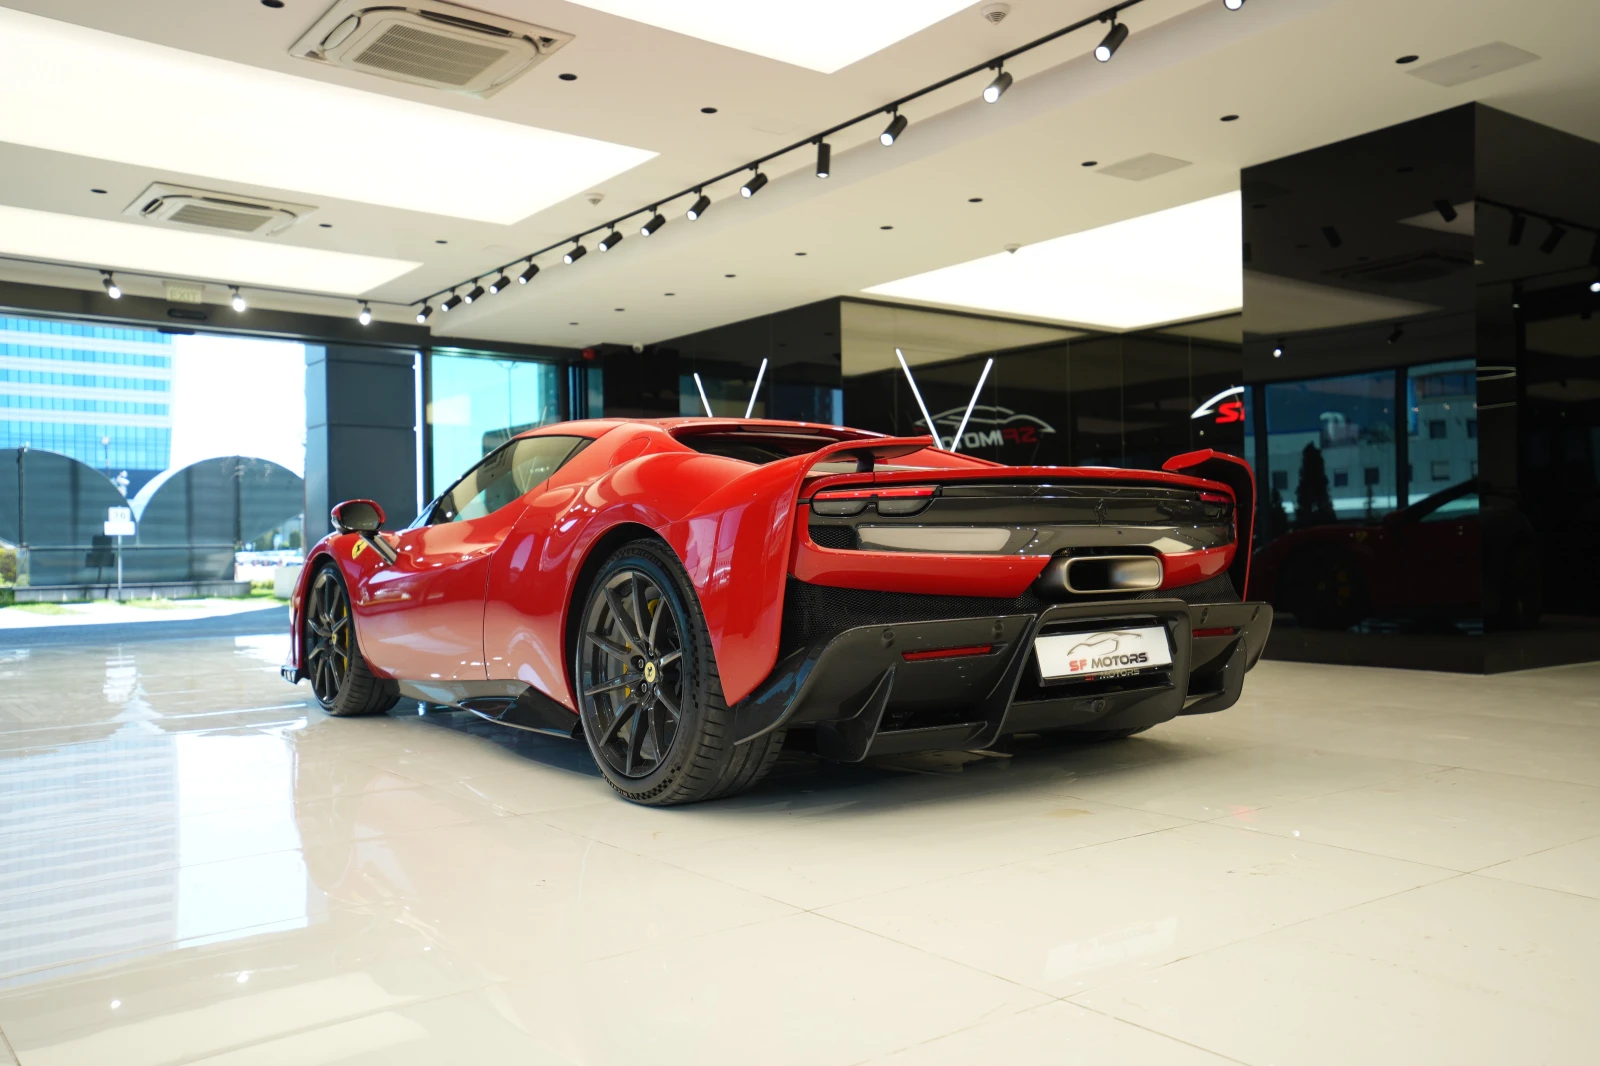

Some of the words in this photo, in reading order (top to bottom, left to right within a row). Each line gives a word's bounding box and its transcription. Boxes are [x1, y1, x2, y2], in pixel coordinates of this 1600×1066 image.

[170, 289, 197, 302] EXIT
[1069, 659, 1087, 671] SF
[1091, 652, 1149, 669] MOTORS
[1099, 668, 1140, 679] MOTORS
